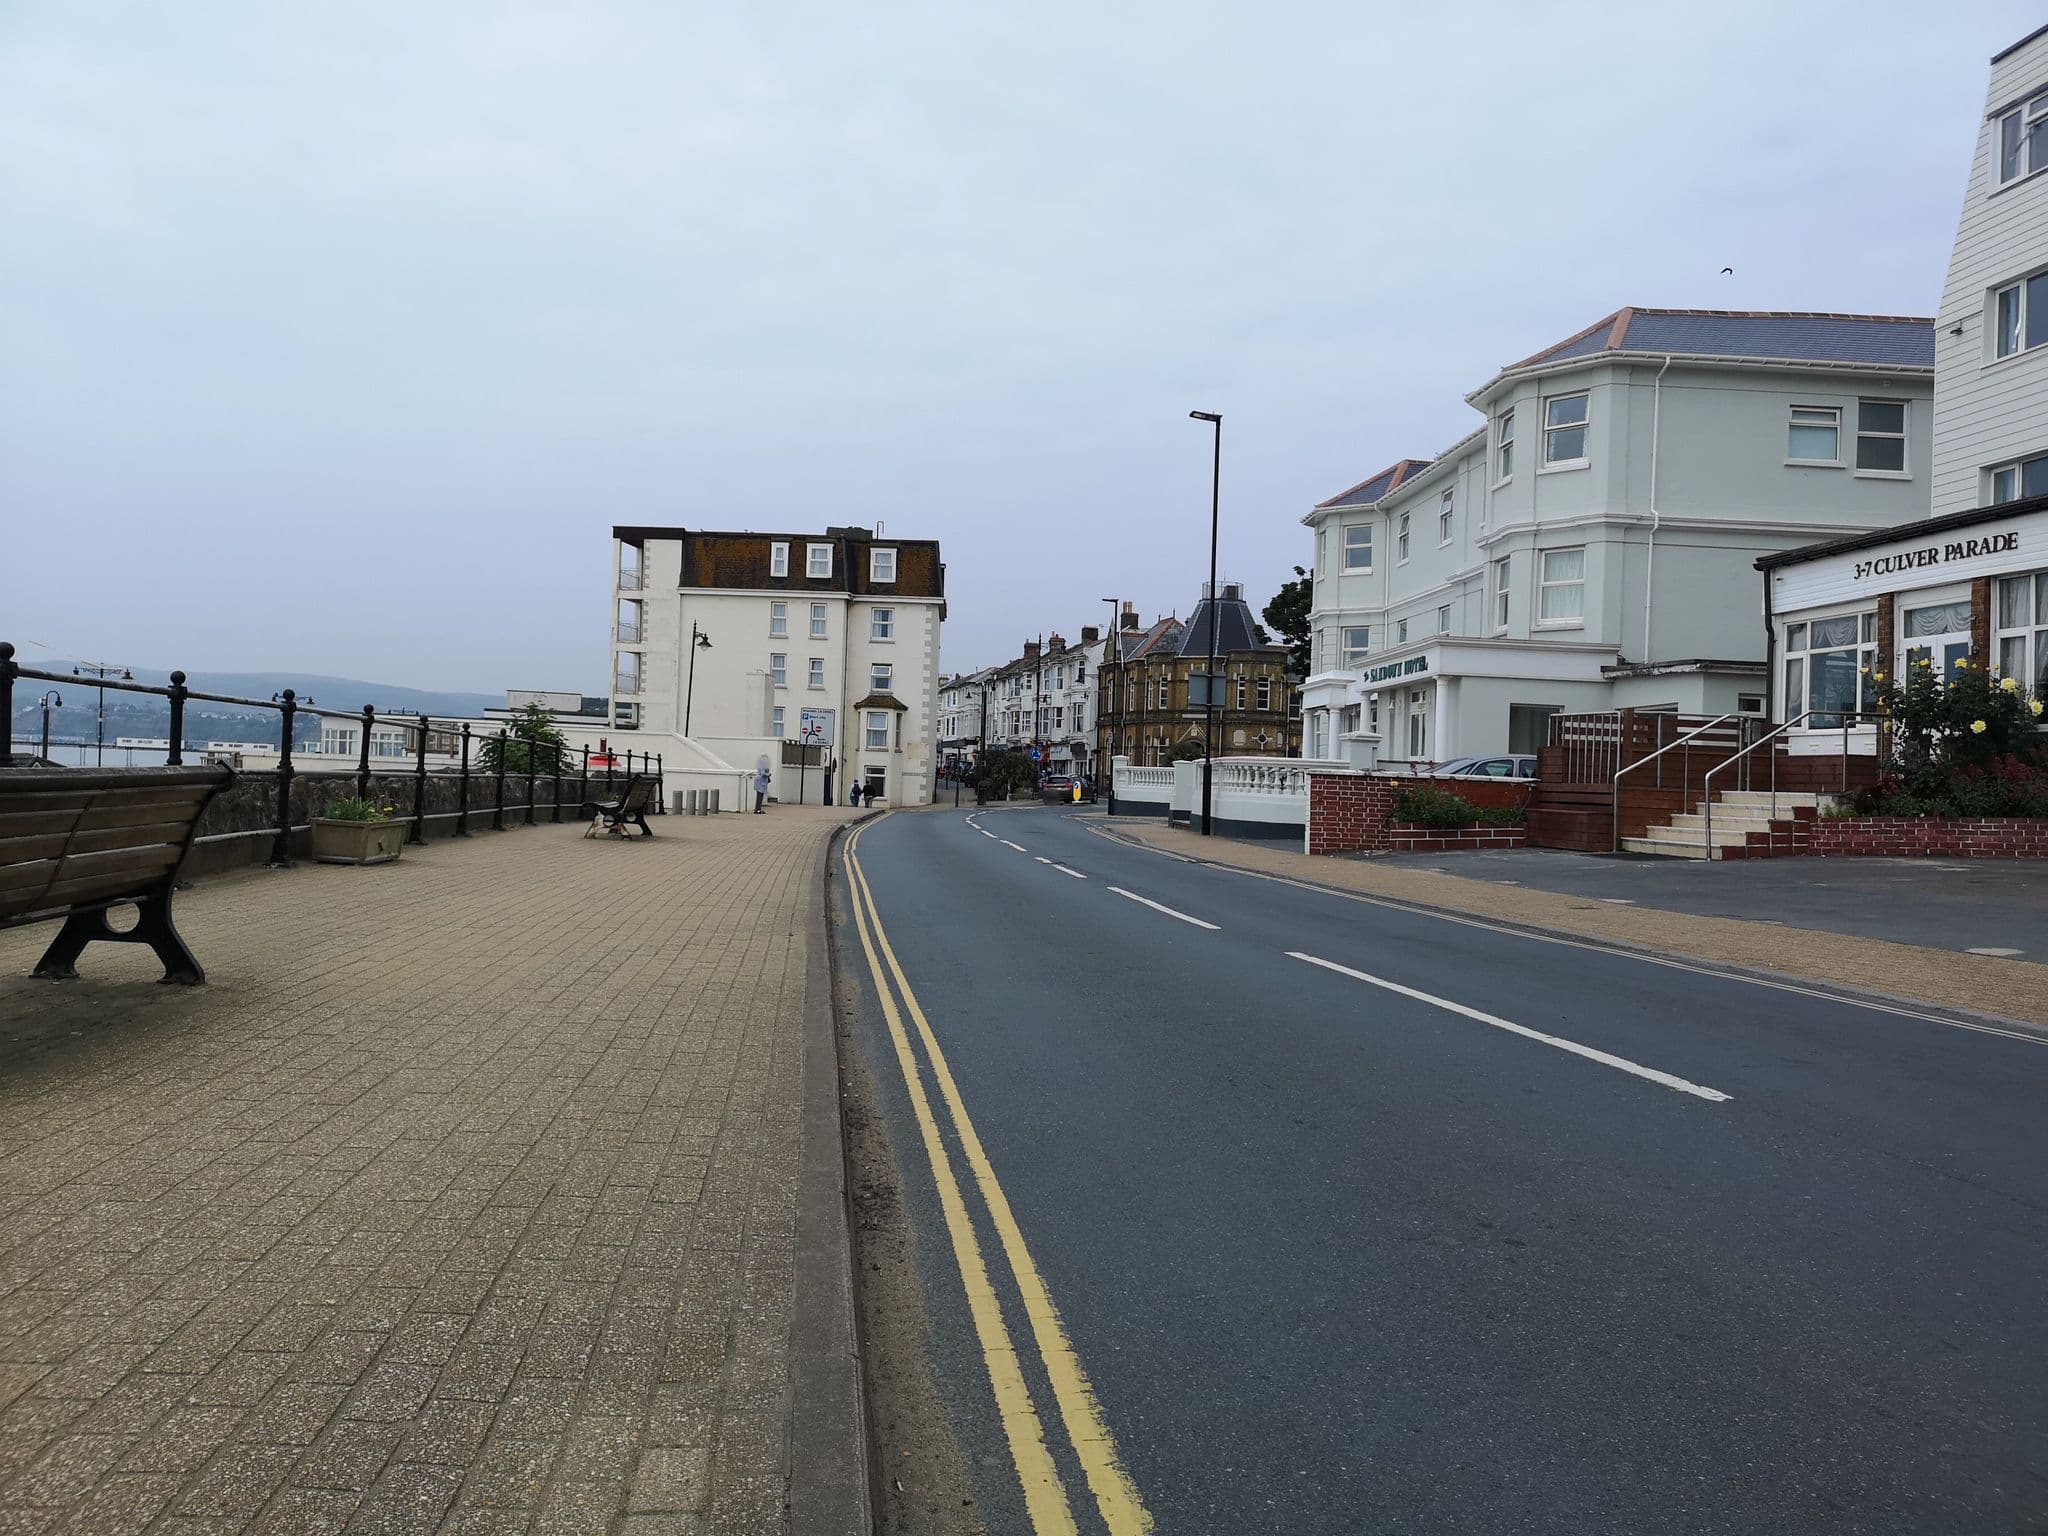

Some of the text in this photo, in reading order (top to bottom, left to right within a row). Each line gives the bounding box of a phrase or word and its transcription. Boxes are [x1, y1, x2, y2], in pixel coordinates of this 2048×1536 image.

[1853, 531, 2019, 580] 3-7 CULVER PARADE
[1404, 655, 1429, 675] HOTEL
